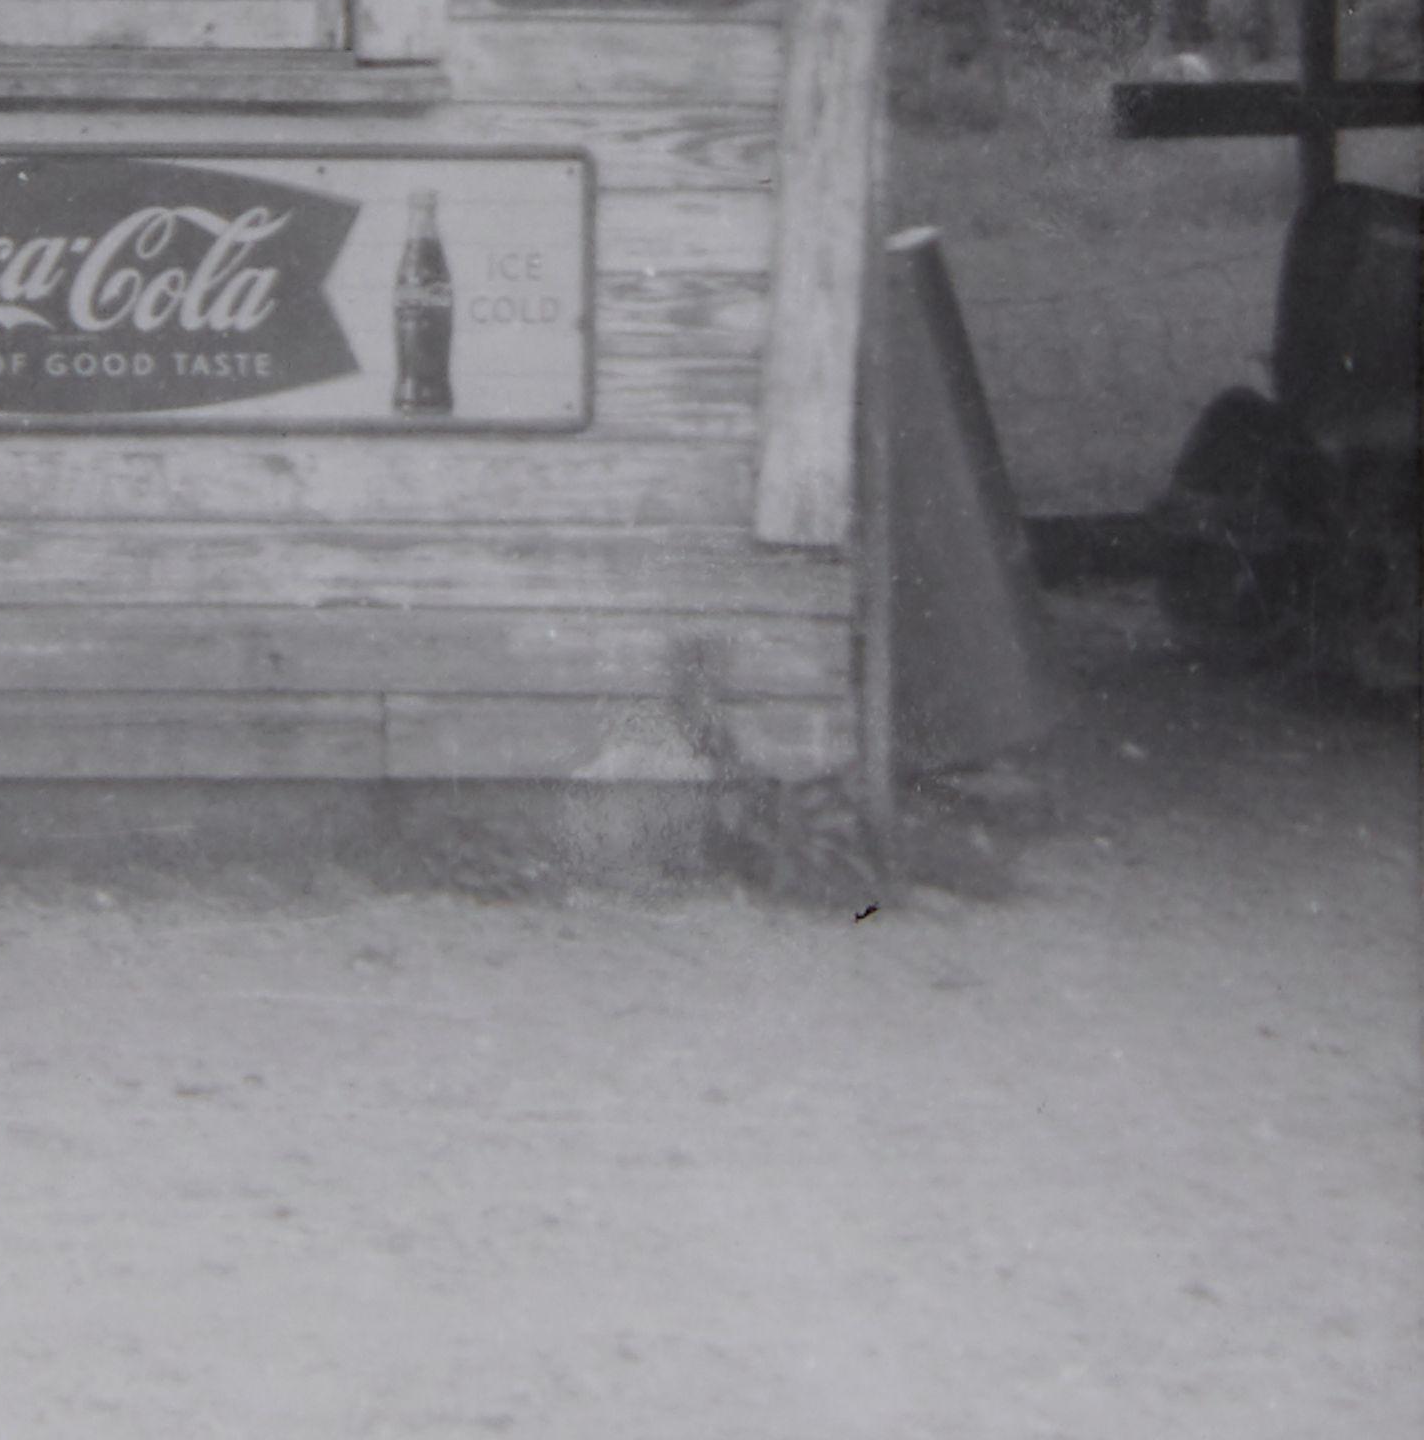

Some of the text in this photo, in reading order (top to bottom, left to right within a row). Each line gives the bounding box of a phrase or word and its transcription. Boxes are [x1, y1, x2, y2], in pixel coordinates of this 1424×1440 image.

[486, 250, 543, 281] ICE
[469, 295, 563, 326] COLD
[44, 352, 153, 376] GOOD
[170, 352, 273, 378] TASTE
